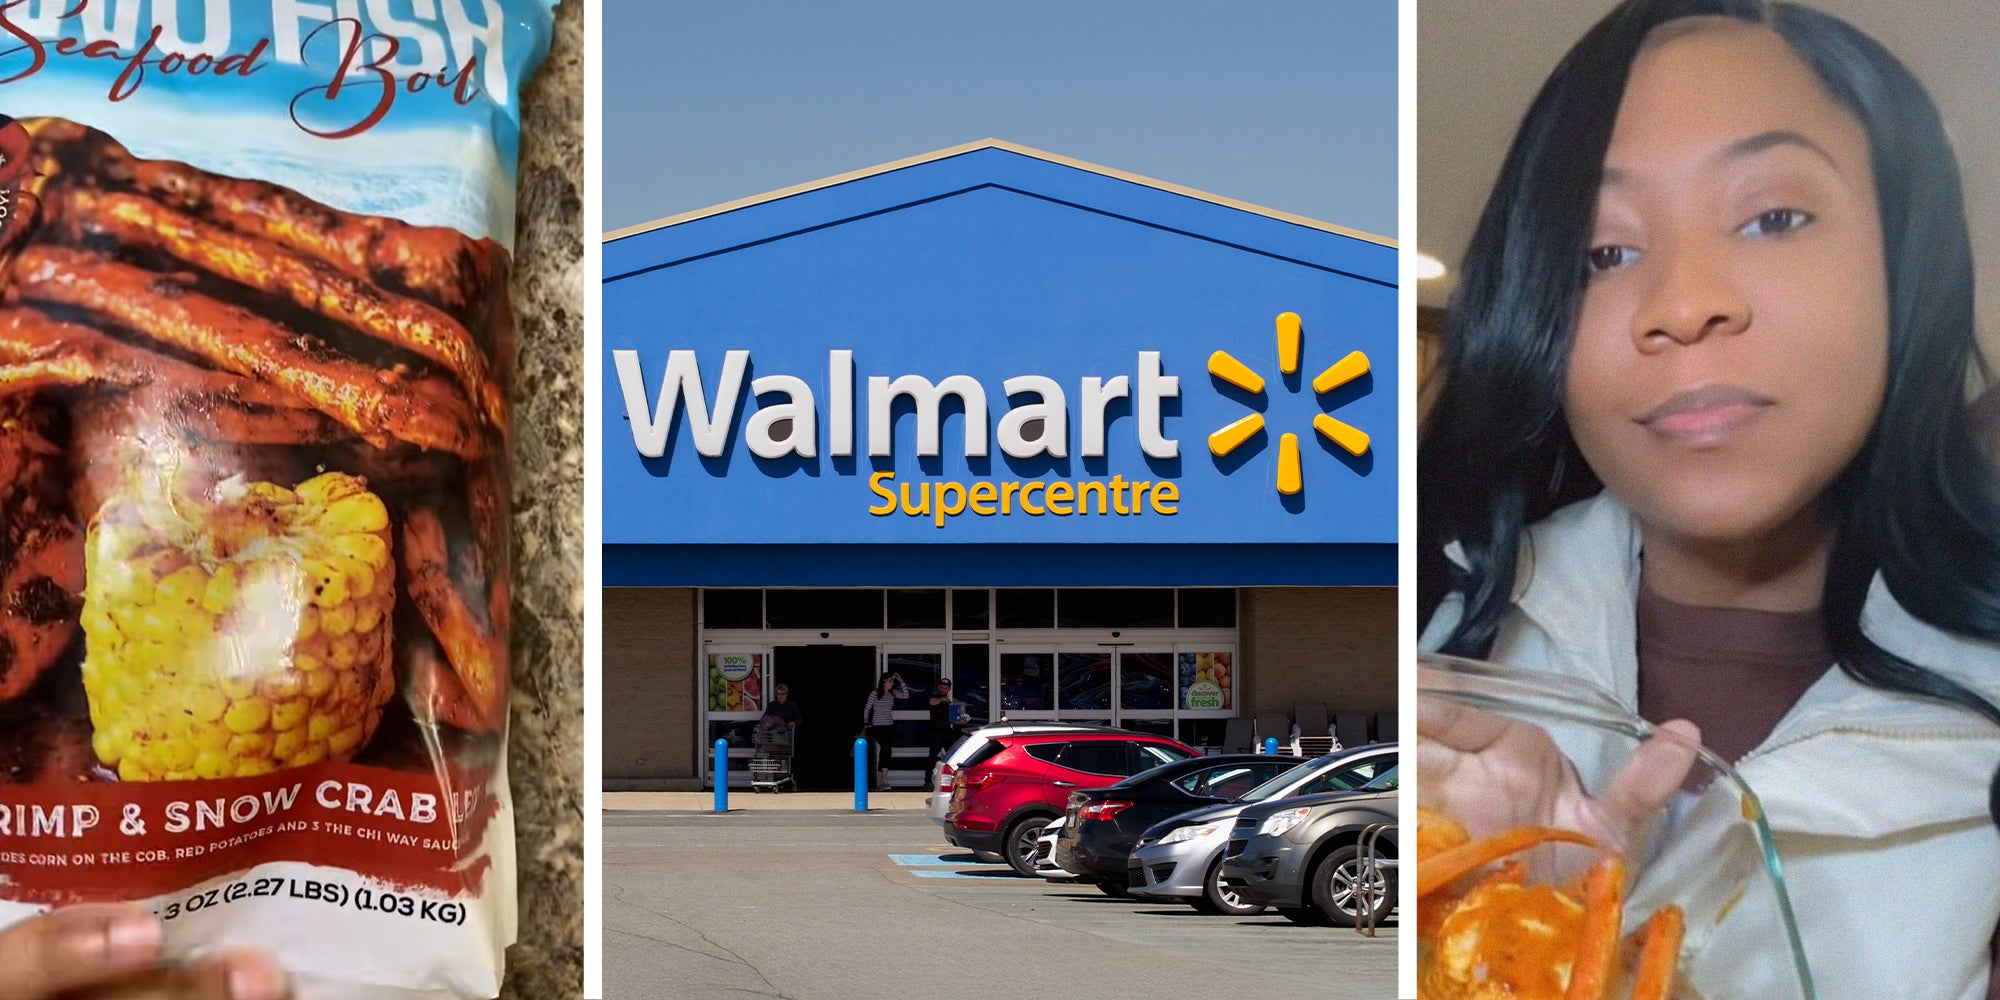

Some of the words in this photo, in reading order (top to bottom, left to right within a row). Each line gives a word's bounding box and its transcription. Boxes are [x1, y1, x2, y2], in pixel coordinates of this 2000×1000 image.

[0, 0, 269, 102] Seafood
[290, 17, 480, 139] Boil
[272, 0, 508, 106] FISH
[612, 349, 1179, 460] Walmart
[869, 470, 1179, 528] Supercentre
[723, 656, 747, 664] 100%
[1191, 697, 1219, 707] fresh
[119, 803, 147, 836] &
[165, 783, 302, 833] SNOW
[315, 780, 437, 824] CRAB
[29, 853, 67, 866] CORN
[72, 853, 95, 865] ON
[102, 852, 131, 864] THE
[175, 845, 205, 859] RED
[209, 826, 273, 853] POTATOES
[277, 821, 307, 833] AND
[312, 821, 320, 832] 3
[325, 822, 352, 836] THE
[357, 827, 381, 841] CHI
[386, 832, 419, 847] WAY
[186, 889, 221, 913] OZ
[224, 878, 284, 904] (2.27
[290, 879, 349, 907] LBS)
[354, 888, 414, 917] (1.03
[420, 900, 466, 926] KG)
